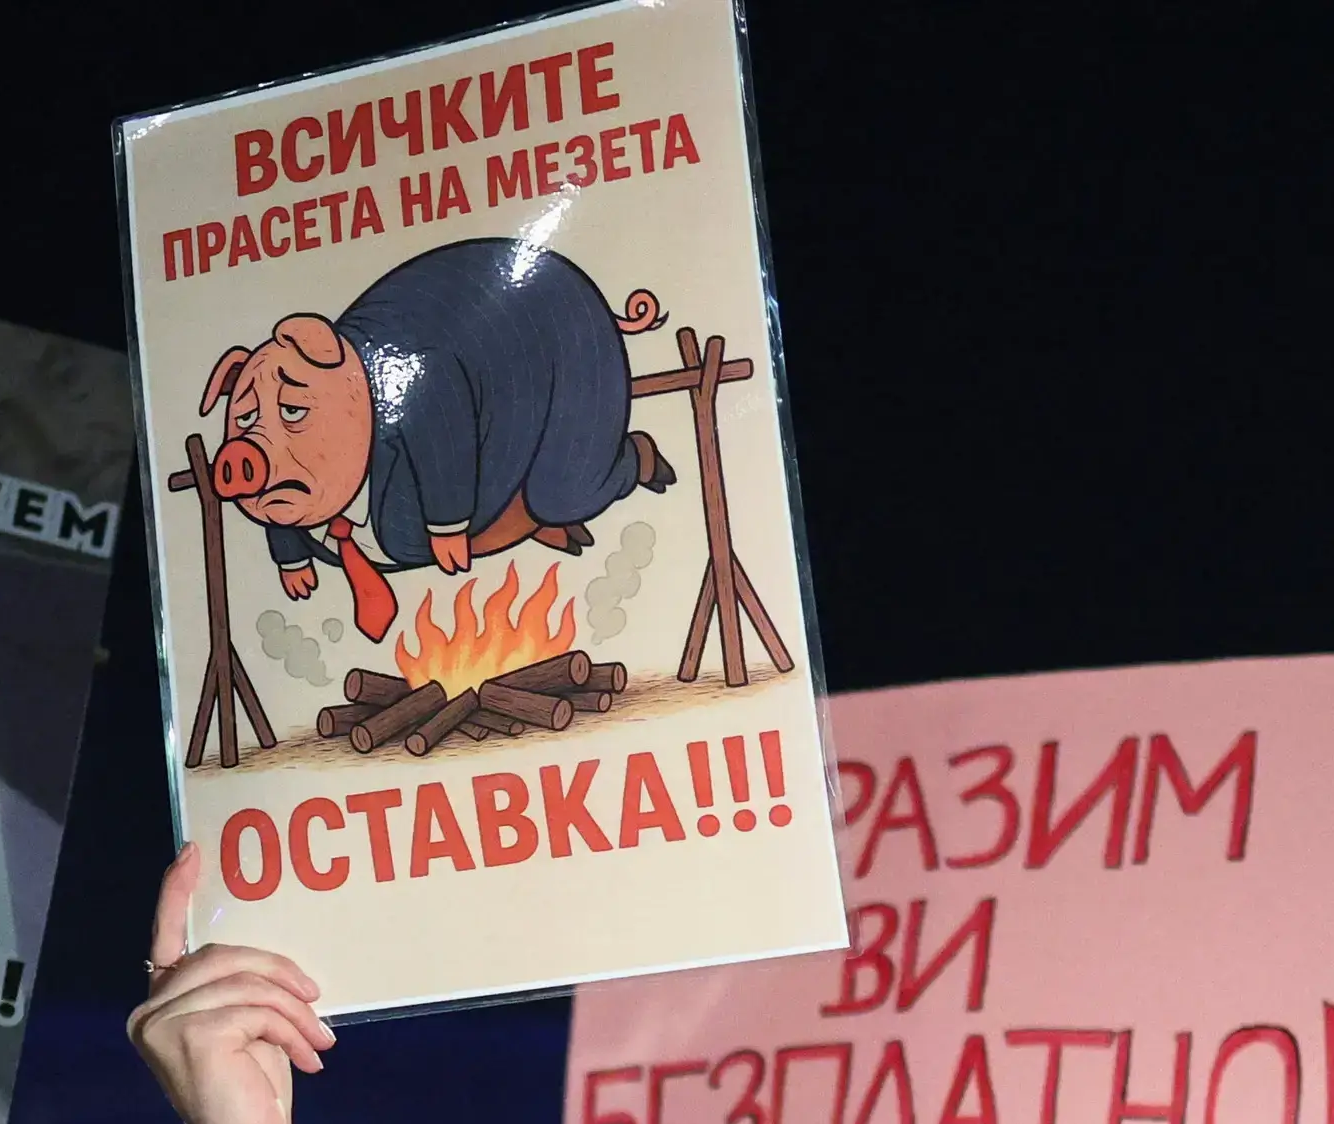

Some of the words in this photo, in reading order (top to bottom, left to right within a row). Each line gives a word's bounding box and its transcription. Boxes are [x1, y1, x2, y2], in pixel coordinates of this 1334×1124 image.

[162, 187, 385, 281] ПРАСЕТА
[400, 165, 472, 227] НА
[485, 113, 702, 208] МЕЗЕТА
[234, 41, 621, 197] ВСИЧКИТЕ
[219, 730, 794, 902] ОСТАВКА!!!
[820, 896, 997, 1018] ВИ
